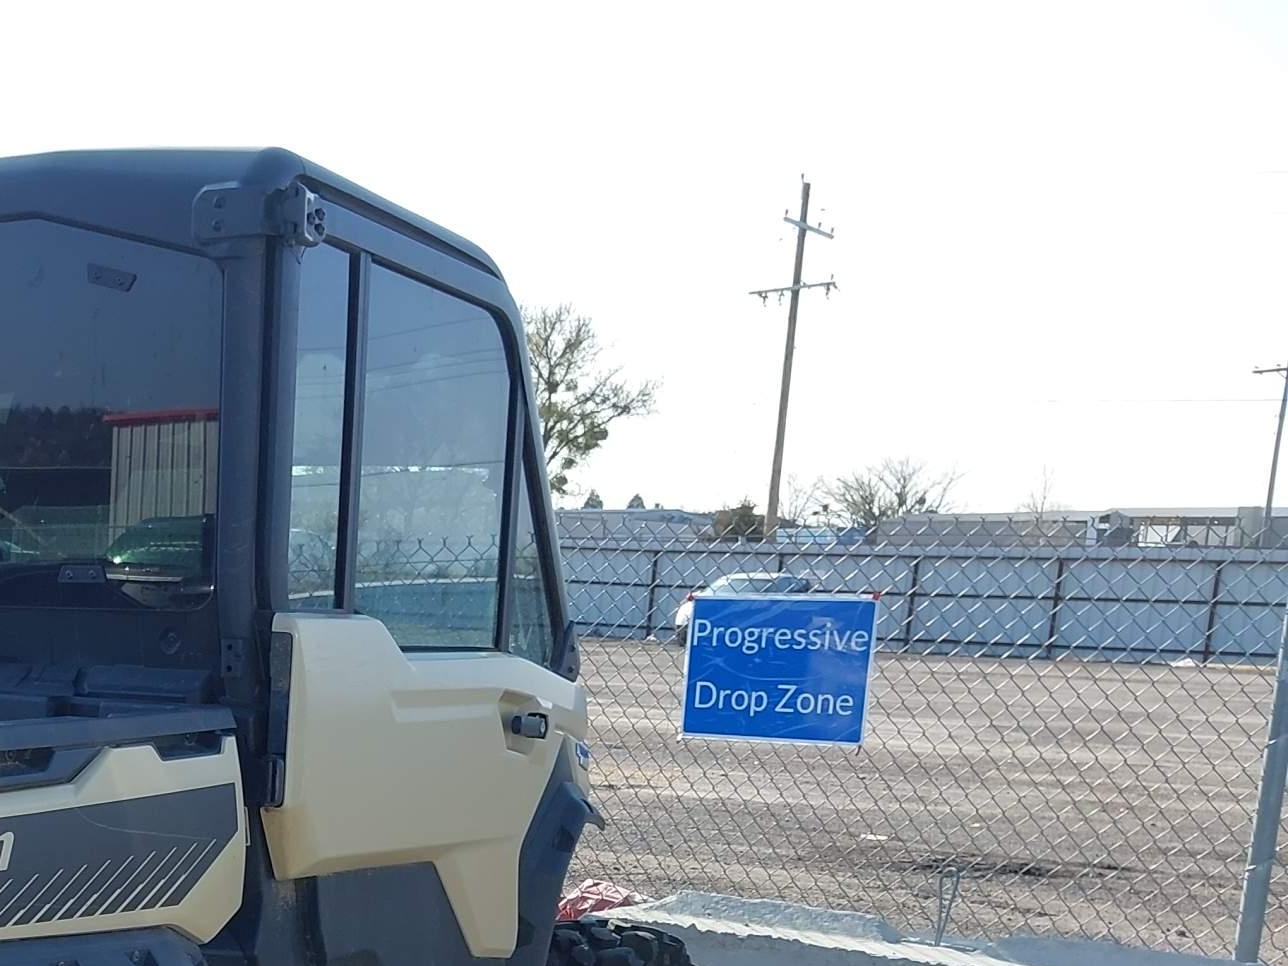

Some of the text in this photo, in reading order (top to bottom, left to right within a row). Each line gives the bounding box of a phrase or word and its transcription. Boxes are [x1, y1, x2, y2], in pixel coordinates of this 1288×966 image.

[692, 618, 869, 655] Progressive
[694, 681, 854, 717] Drop Zone
